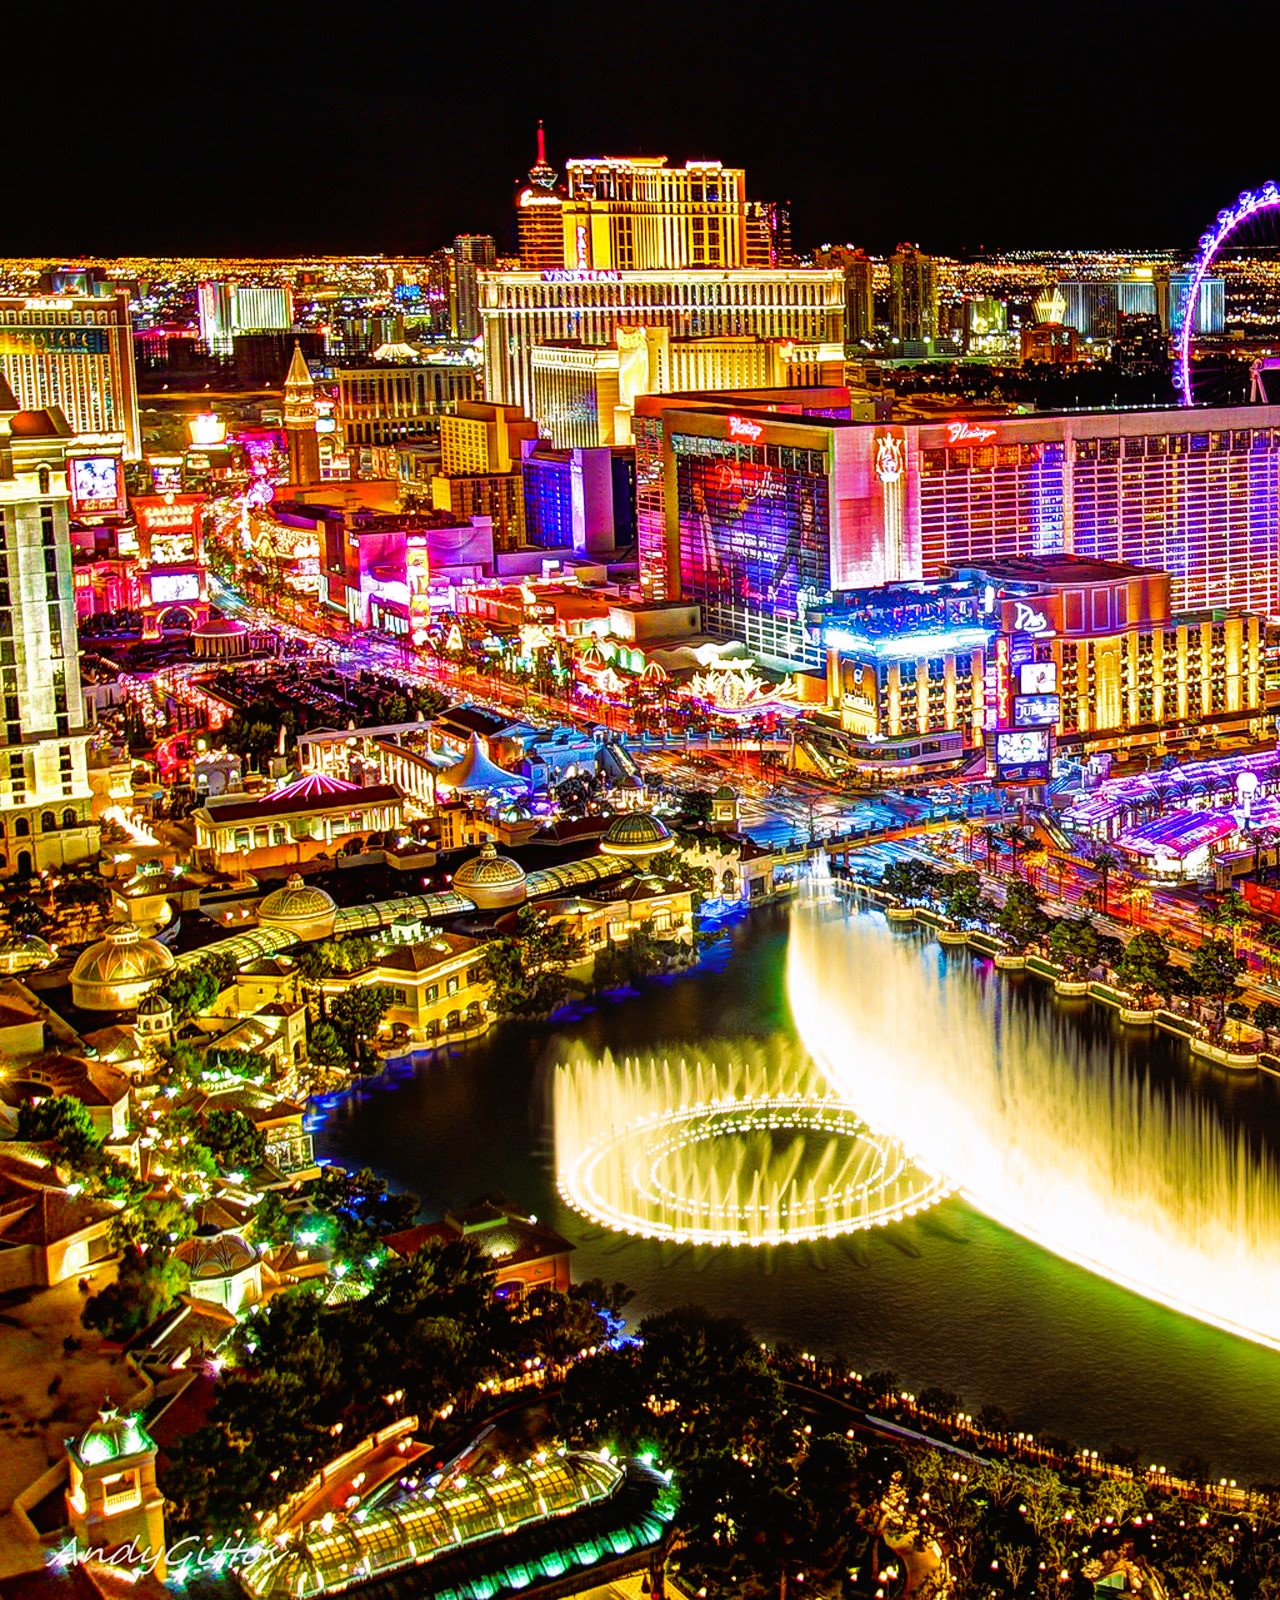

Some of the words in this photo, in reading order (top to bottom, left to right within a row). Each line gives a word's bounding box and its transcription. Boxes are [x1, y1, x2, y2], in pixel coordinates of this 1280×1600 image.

[543, 270, 618, 282] VENETIAN
[729, 416, 763, 441] Flamingo
[947, 421, 997, 443] Flamingo
[144, 505, 195, 518] CAESARS
